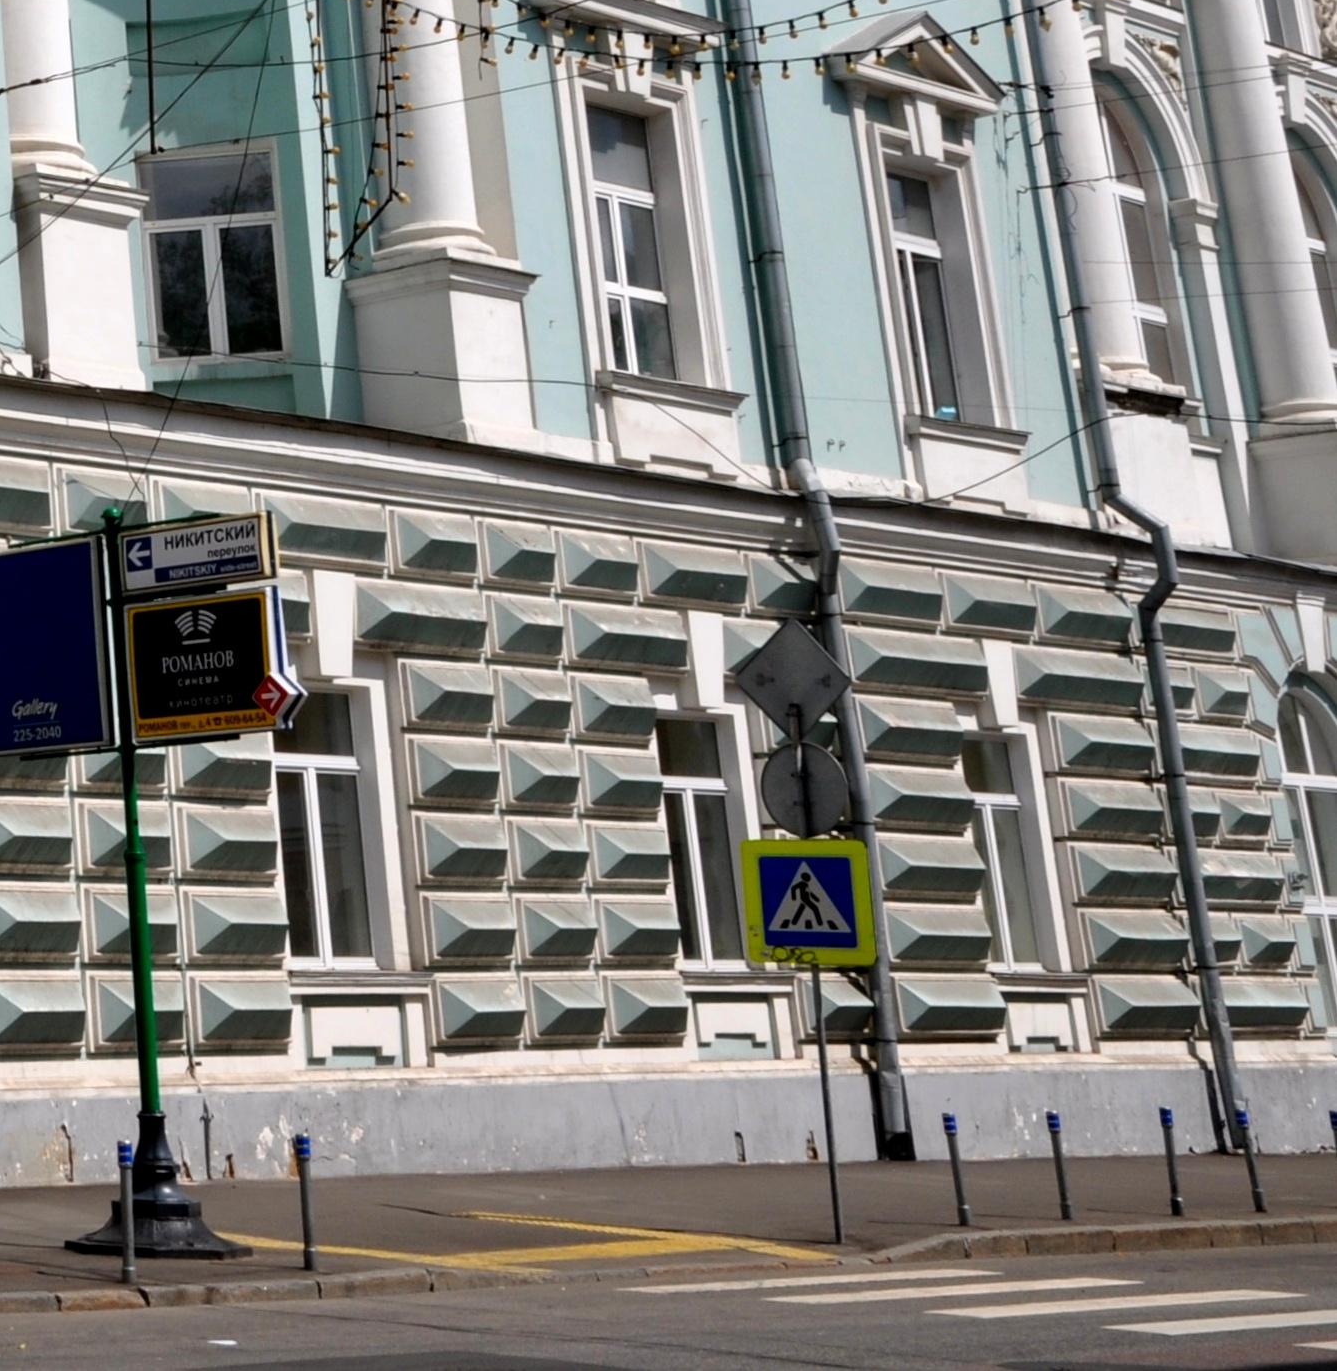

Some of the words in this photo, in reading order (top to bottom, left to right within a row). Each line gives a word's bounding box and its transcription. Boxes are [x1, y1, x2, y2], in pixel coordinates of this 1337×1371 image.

[163, 520, 256, 551] НИКИТСКИЙ
[207, 544, 256, 560] переулок
[168, 562, 218, 580] NIKITSKIY
[160, 649, 236, 675] РОМАНОВ
[176, 674, 221, 688] СИНЕМА
[10, 696, 59, 721] Gallery
[168, 693, 235, 709] кинотеатр
[12, 725, 62, 743] 225-2040
